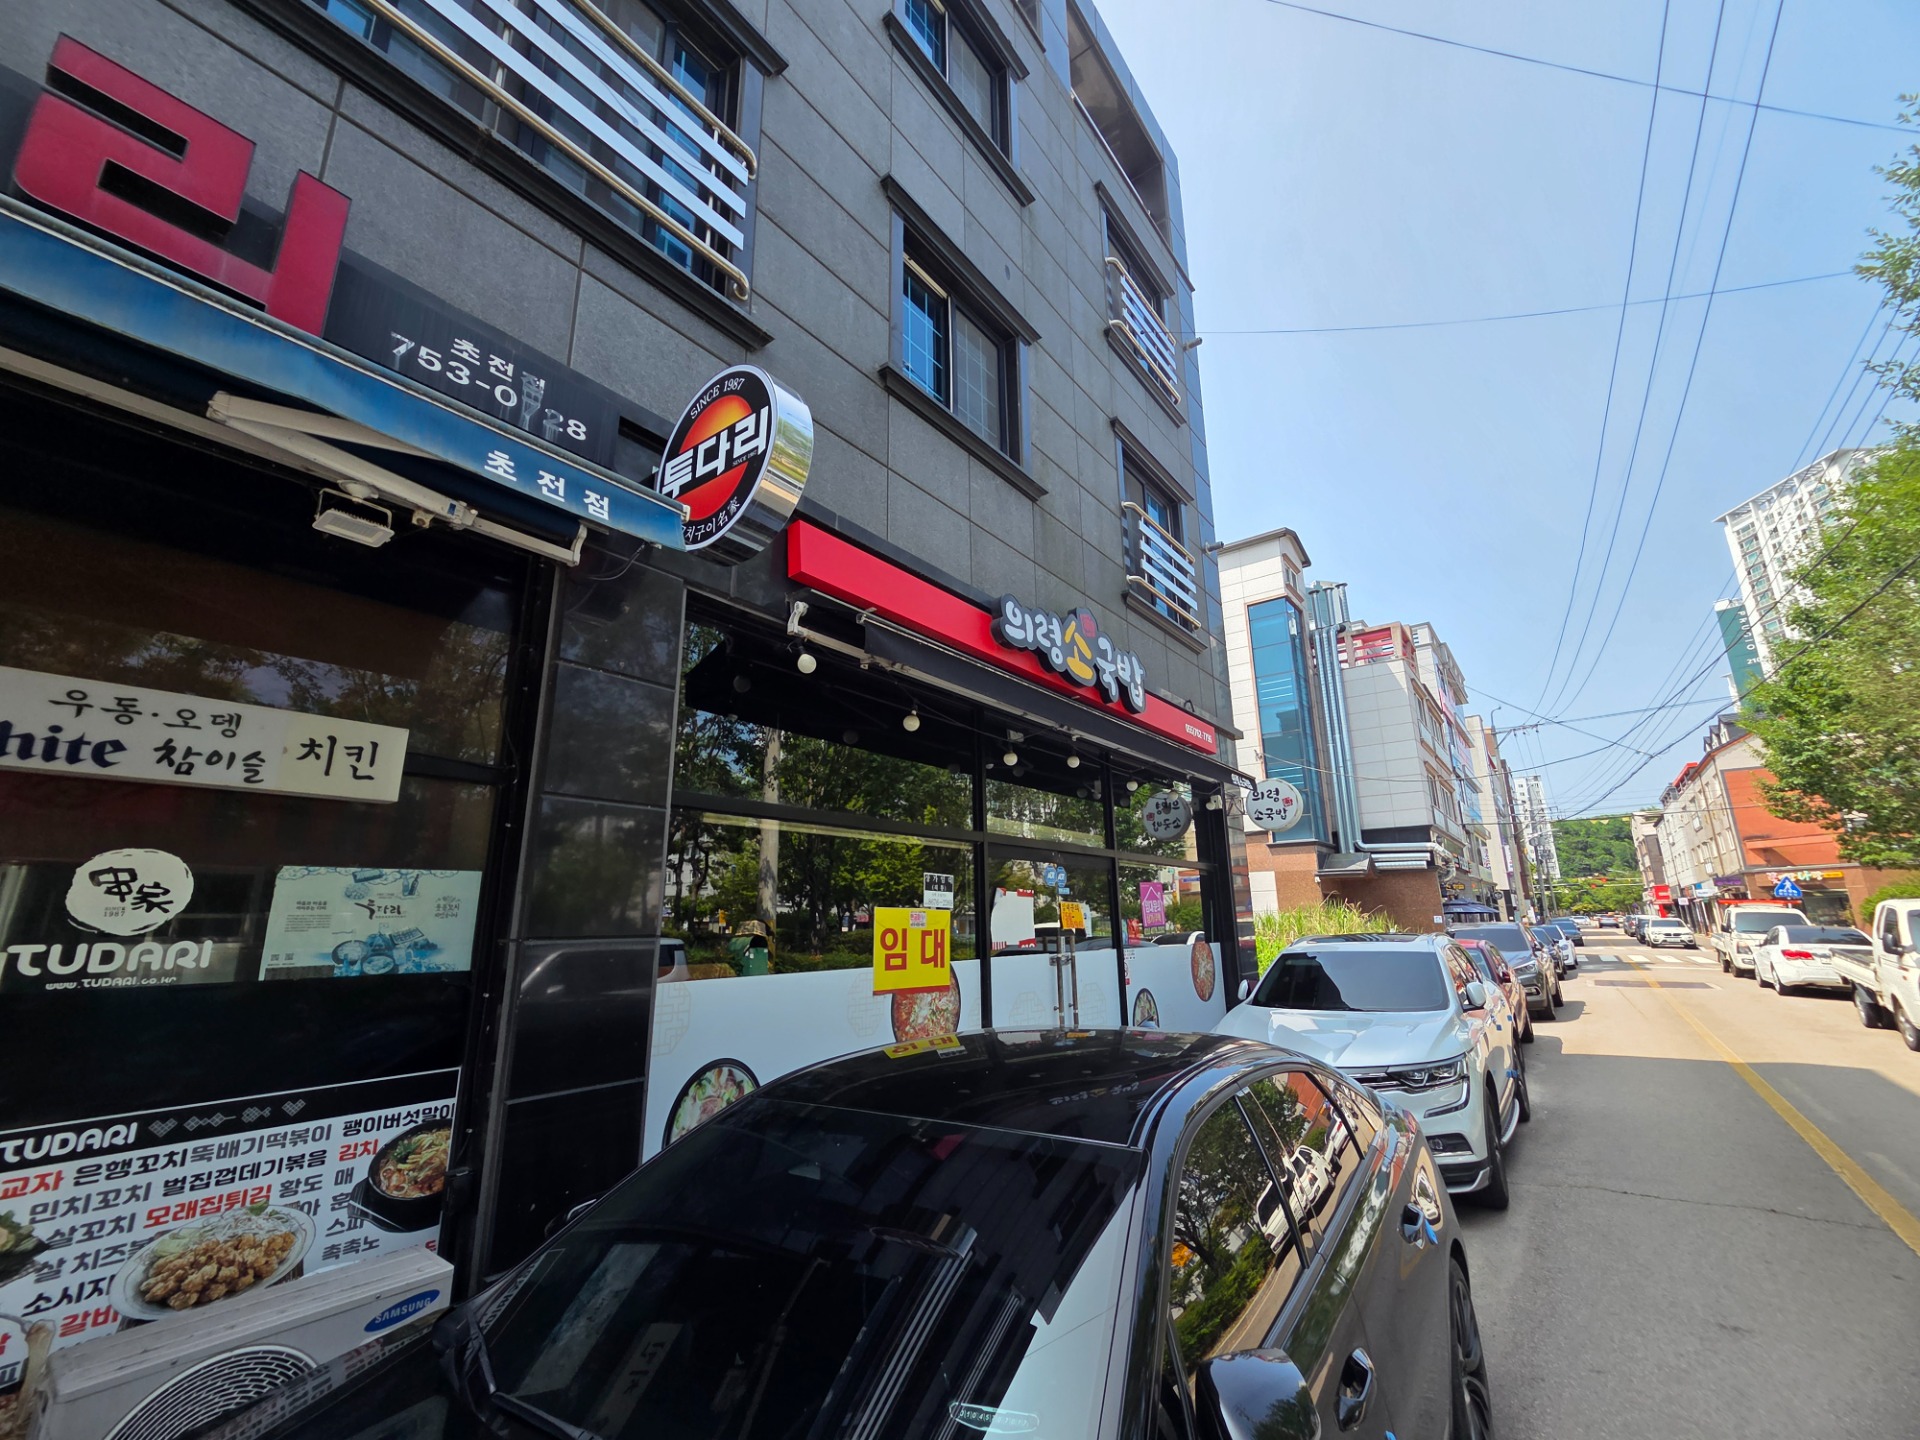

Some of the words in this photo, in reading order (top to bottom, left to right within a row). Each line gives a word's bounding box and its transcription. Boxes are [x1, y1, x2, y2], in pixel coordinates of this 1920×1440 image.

[690, 384, 721, 420] SINCE
[723, 377, 745, 392] 1987
[662, 405, 769, 499] 투다리
[484, 450, 610, 521] 초전점
[1004, 600, 1145, 708] 의령소국밥
[153, 737, 266, 784] 참이슬
[296, 734, 380, 782] 치킨
[1251, 787, 1280, 803] 의령
[1254, 807, 1288, 821] 소국밥
[7, 939, 213, 977] TUDARI
[880, 927, 946, 971] 임대
[0, 1121, 138, 1164] TUDARI
[73, 1148, 189, 1187] 은행꼬치
[190, 1124, 333, 1163] 뚝배기떡볶이
[342, 1102, 456, 1138] 팽이버섯말이
[29, 1181, 153, 1225] 민치꼬치
[162, 1149, 328, 1197] 벌집껍데기볶음
[338, 1138, 379, 1162] 김치
[143, 1183, 272, 1229] 모래집튀김
[278, 1173, 324, 1199] 황도
[21, 1273, 117, 1317] 소시지
[374, 1297, 432, 1324] SAMSUNG
